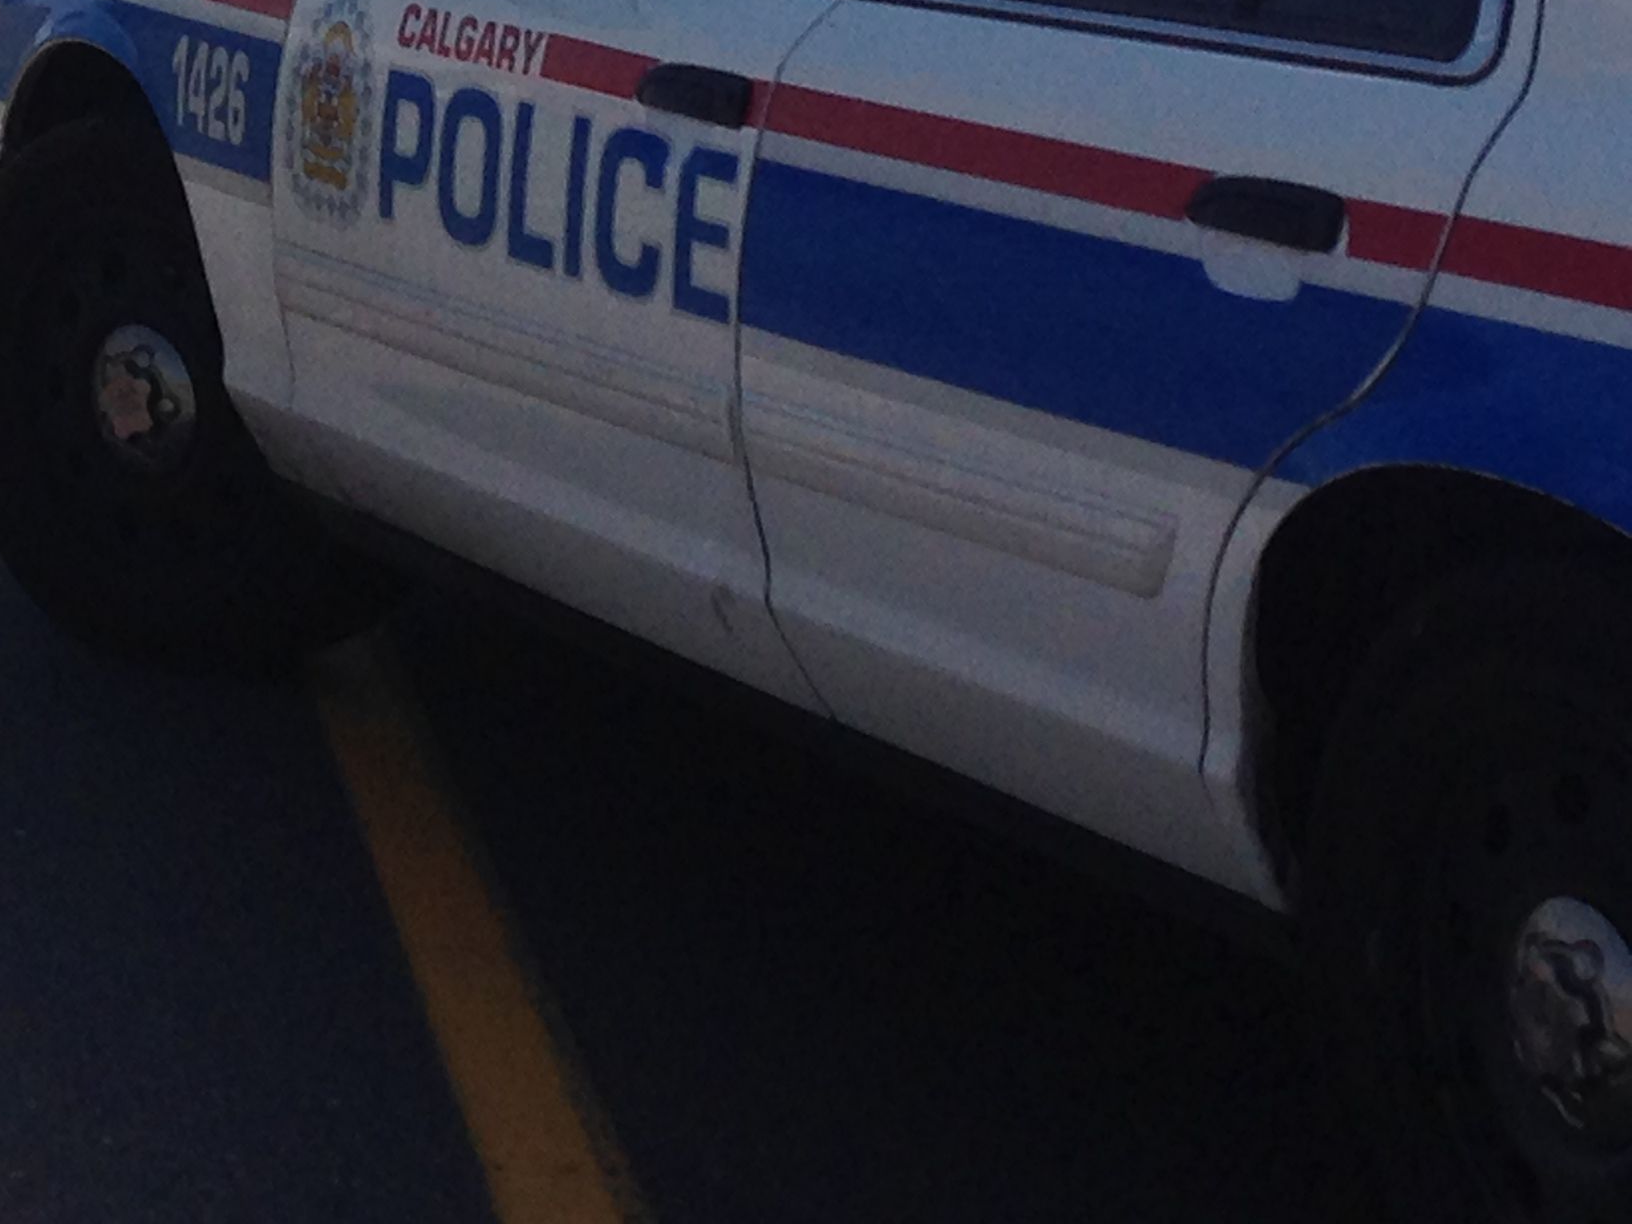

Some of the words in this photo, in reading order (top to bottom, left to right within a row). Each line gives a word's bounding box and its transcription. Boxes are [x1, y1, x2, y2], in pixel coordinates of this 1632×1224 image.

[172, 33, 250, 147] 1426
[398, 2, 545, 77] CALGARY
[378, 68, 743, 325] POLICE
